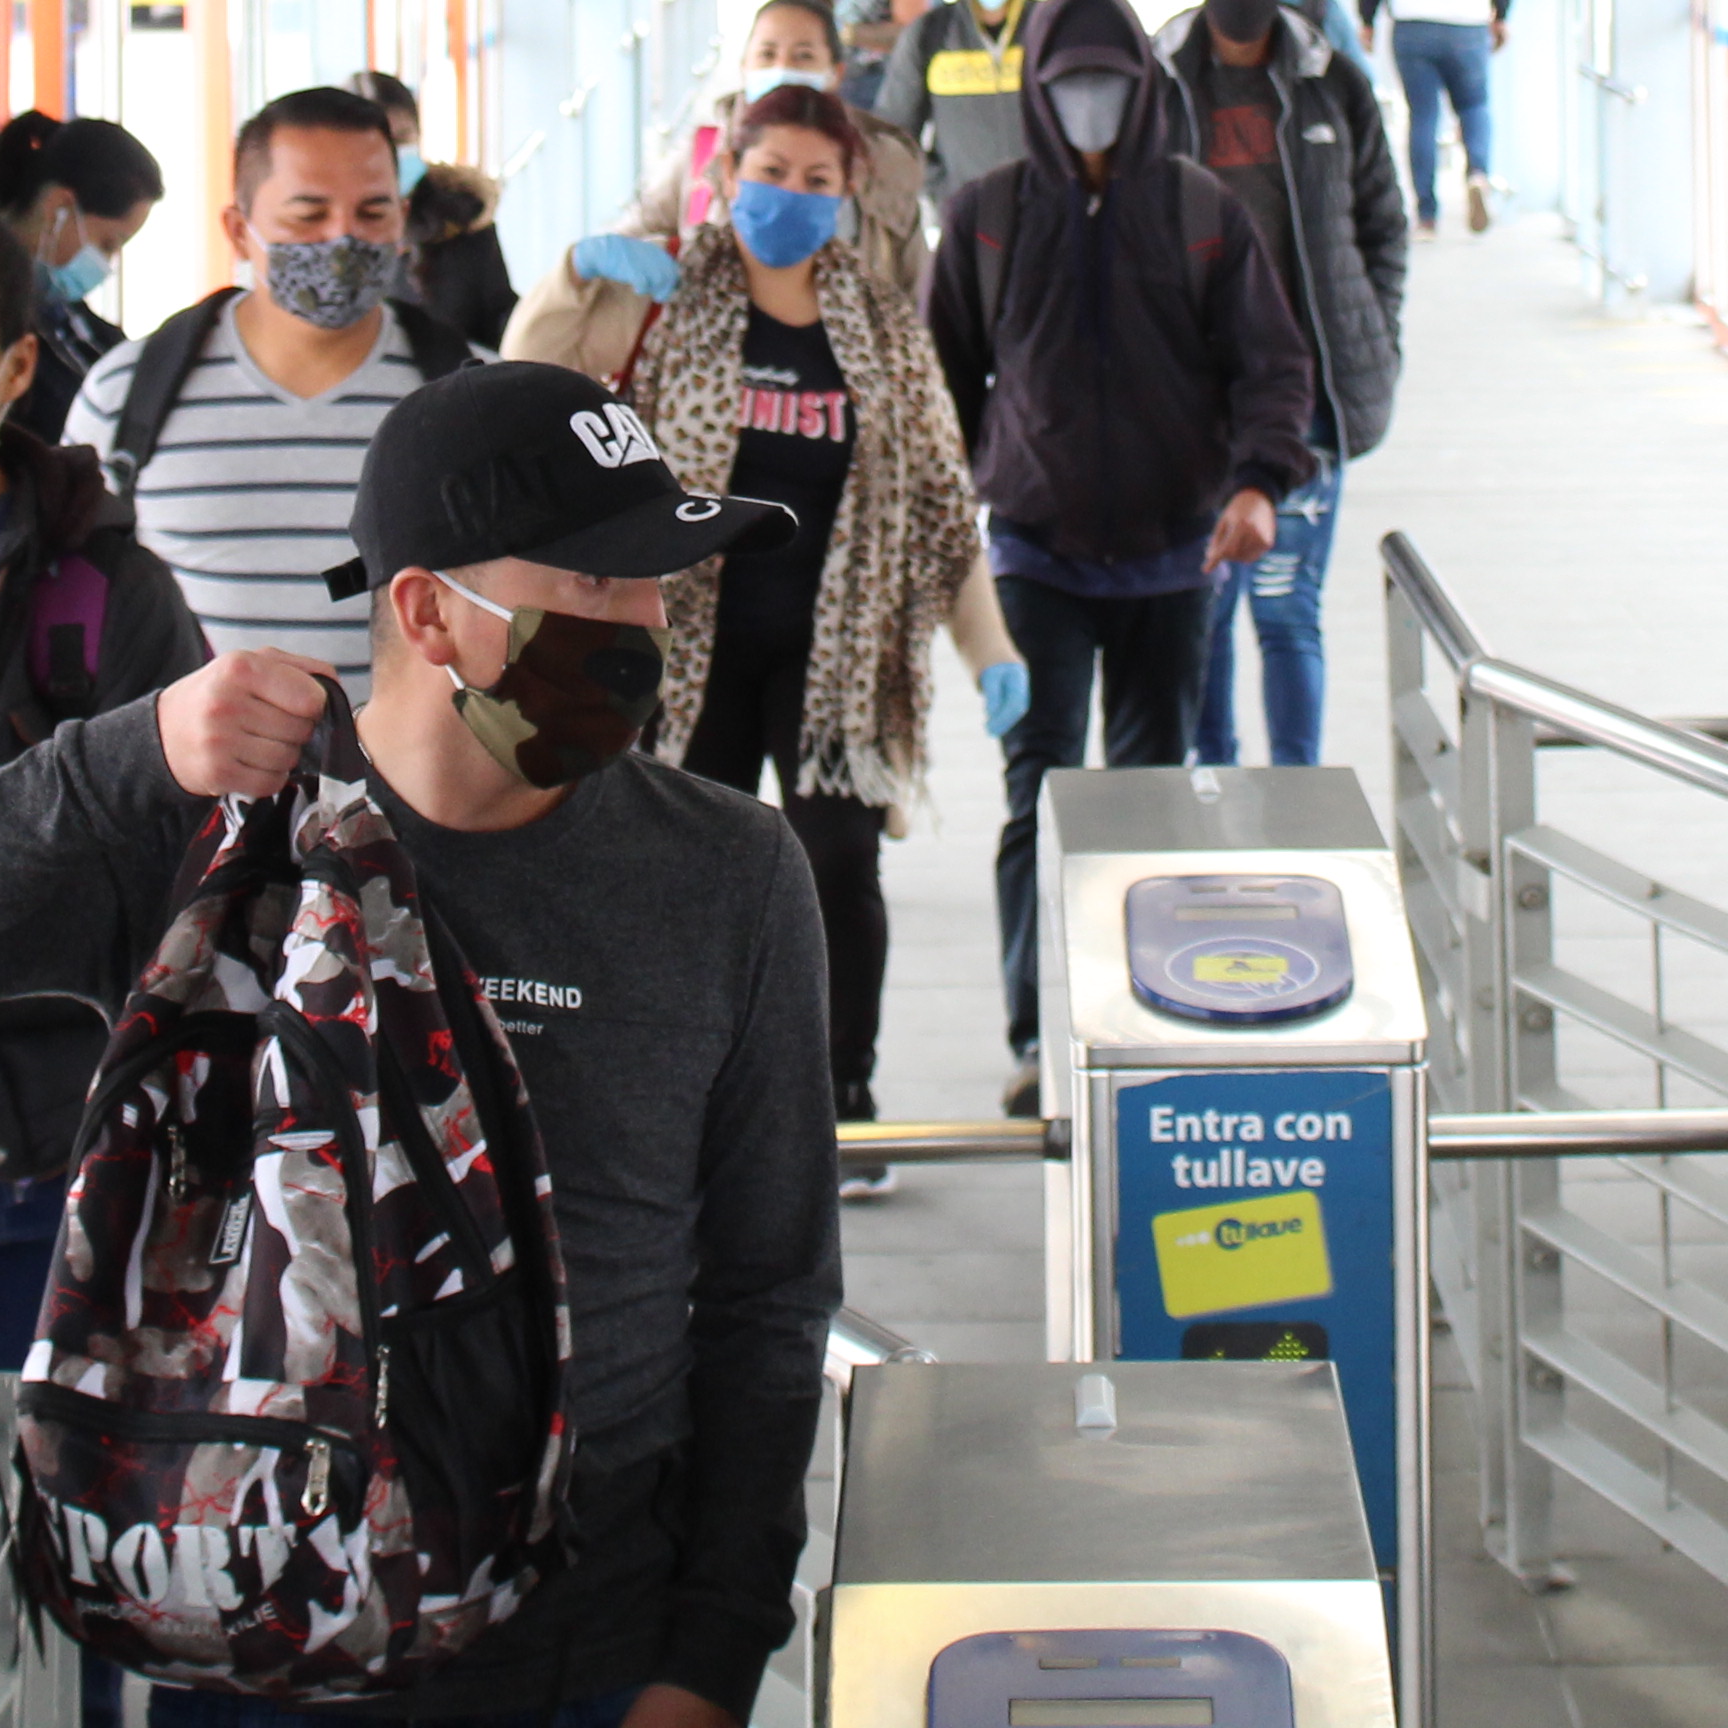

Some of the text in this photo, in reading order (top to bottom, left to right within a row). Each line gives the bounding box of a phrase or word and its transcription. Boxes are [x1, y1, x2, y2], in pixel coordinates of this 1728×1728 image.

[478, 976, 583, 1010] EEKEND
[1149, 1105, 1353, 1143] Entra con
[1171, 1147, 1327, 1189] tullave
